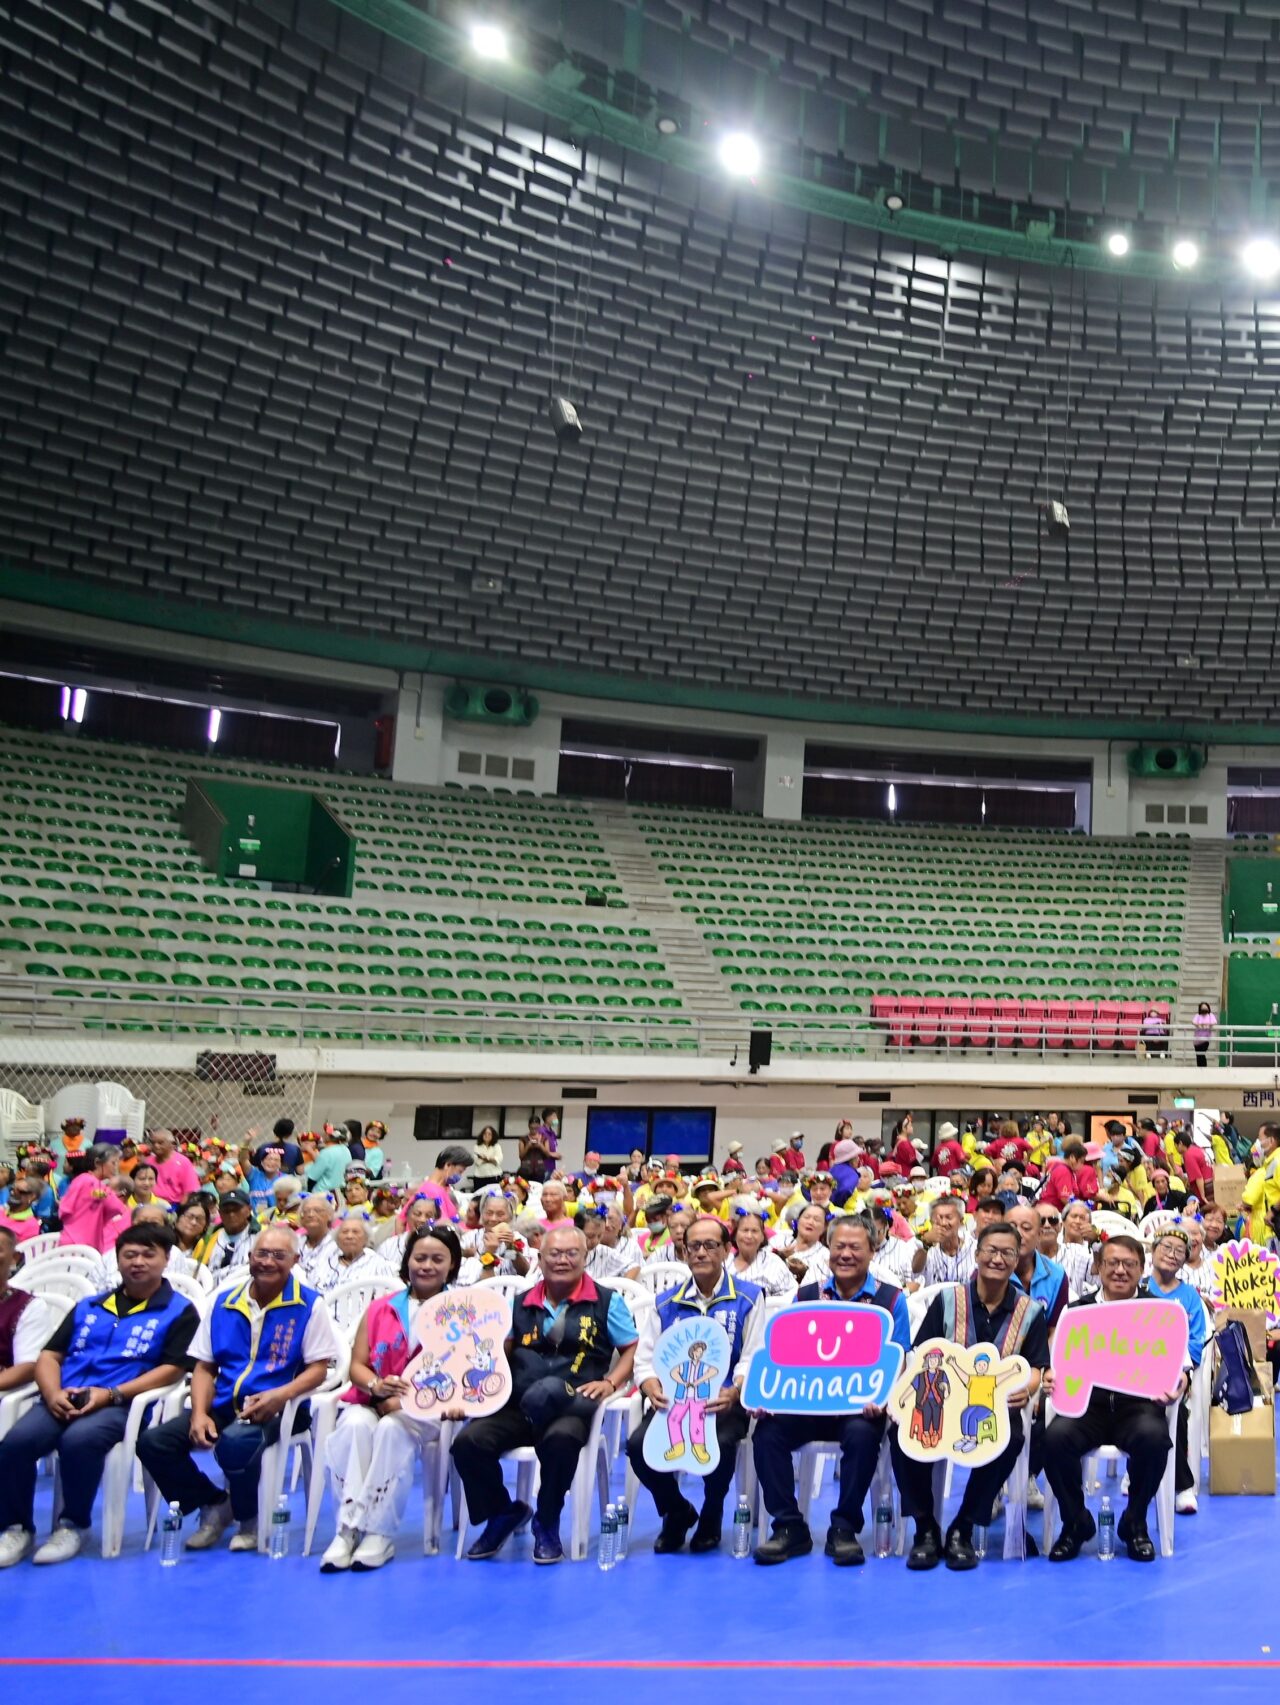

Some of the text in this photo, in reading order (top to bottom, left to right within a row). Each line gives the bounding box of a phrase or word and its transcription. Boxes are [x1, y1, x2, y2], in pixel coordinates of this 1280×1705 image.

[1243, 1090, 1275, 1108] 西門
[1224, 1272, 1276, 1302] Akokey
[759, 1366, 884, 1404] Uninang
